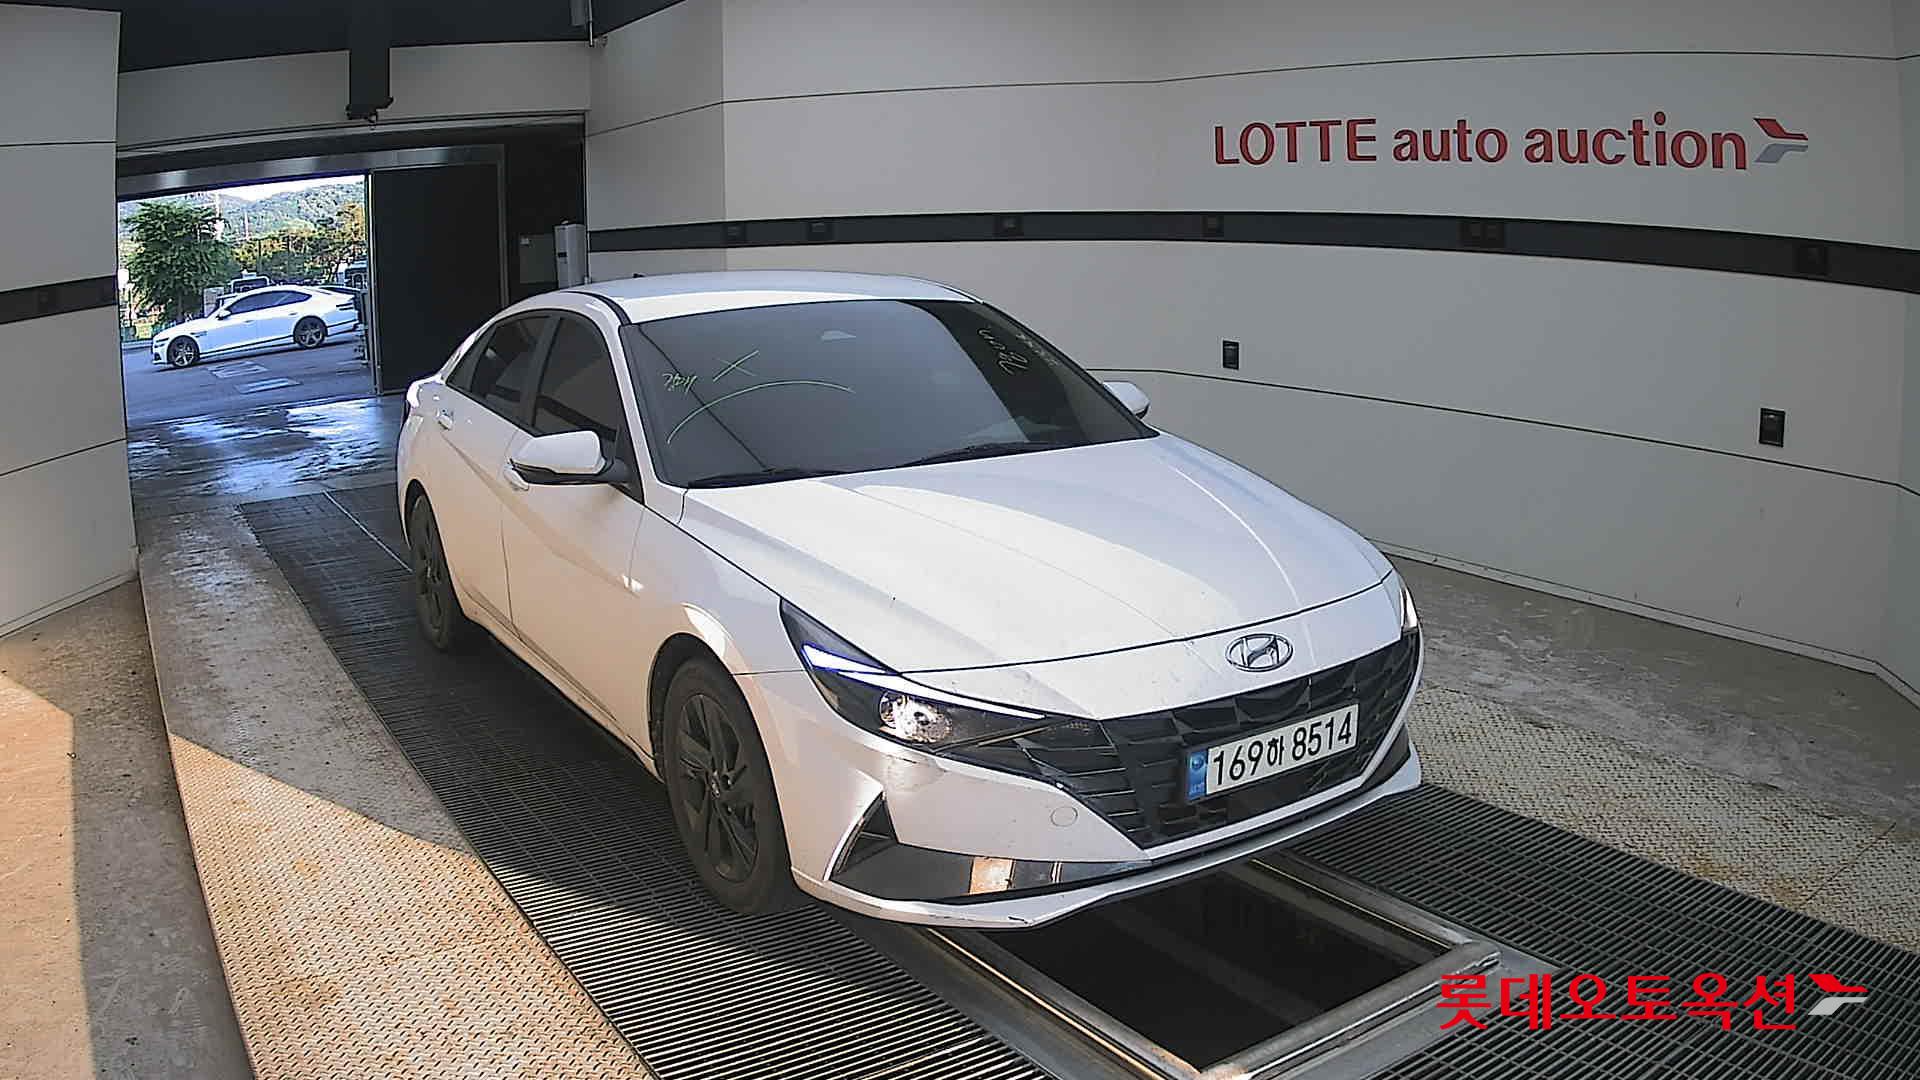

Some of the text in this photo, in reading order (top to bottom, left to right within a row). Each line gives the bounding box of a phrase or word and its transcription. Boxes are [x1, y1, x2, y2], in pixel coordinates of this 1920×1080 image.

[1214, 111, 1749, 171] LOTTE auto auction
[1212, 710, 1353, 787] 169하 8514
